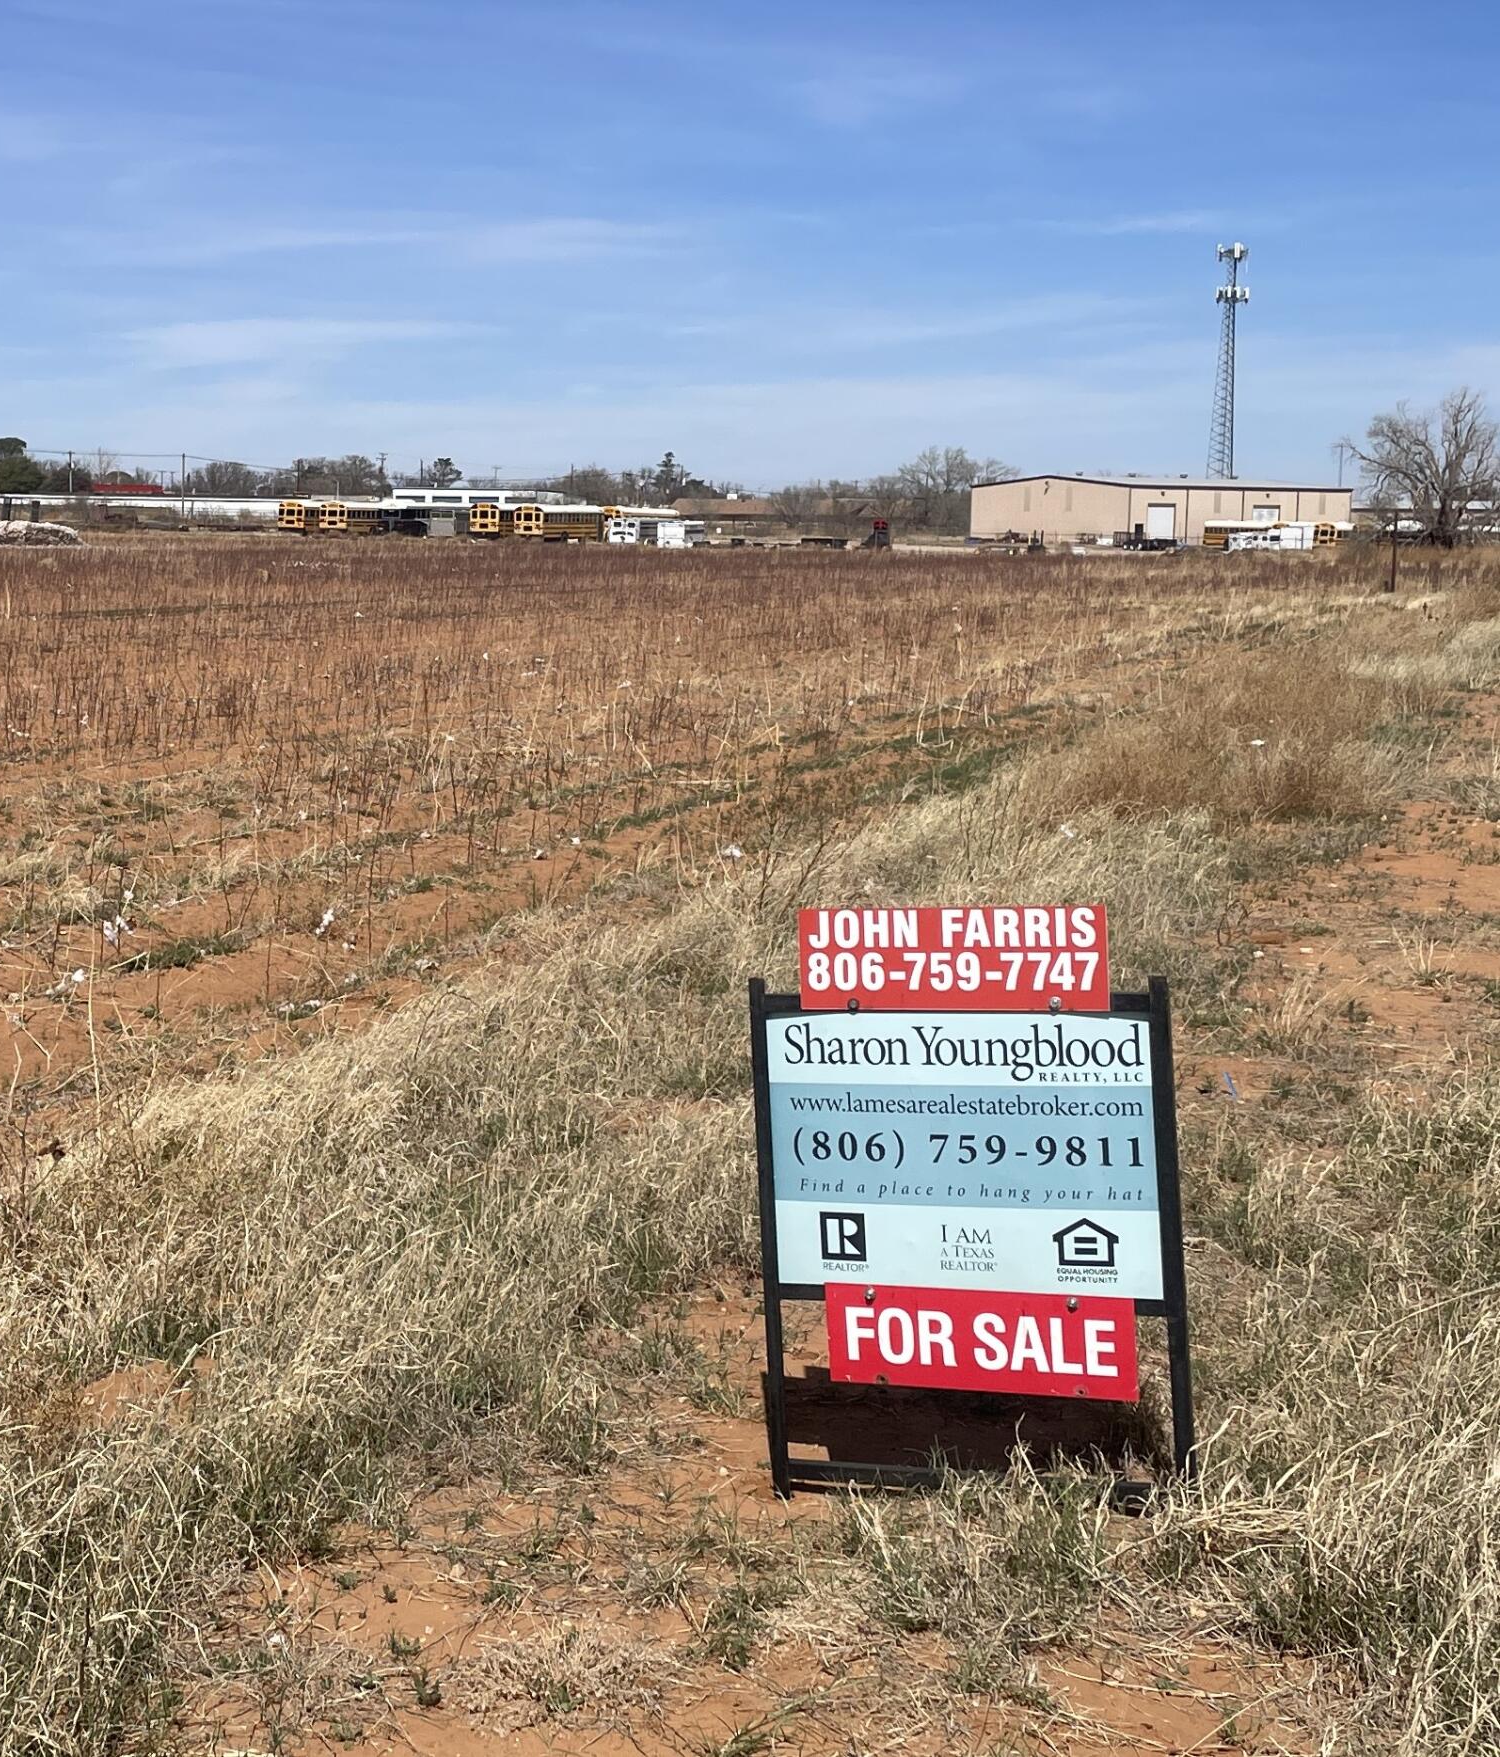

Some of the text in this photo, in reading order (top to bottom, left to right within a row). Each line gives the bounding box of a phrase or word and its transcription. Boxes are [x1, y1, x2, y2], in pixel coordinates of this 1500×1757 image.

[808, 907, 1096, 948] JOHN FARRIS
[808, 951, 1100, 992] 806-759-7747
[784, 1022, 1145, 1082] Sharon Youngblood
[1038, 1072, 1144, 1084] REALTY, LLC
[790, 1092, 1144, 1117] www.lamesarealestatebroker.com
[793, 1127, 1145, 1169] (806) 759-9811
[799, 1178, 1144, 1202] Find a place to hang your hat
[941, 1224, 992, 1245] I AM
[952, 1245, 995, 1259] TEXAS
[1056, 1267, 1119, 1276] EQUAL HOUSING
[1057, 1275, 1119, 1284] OPPORTUNITY
[844, 1305, 1119, 1378] FOR SALE
